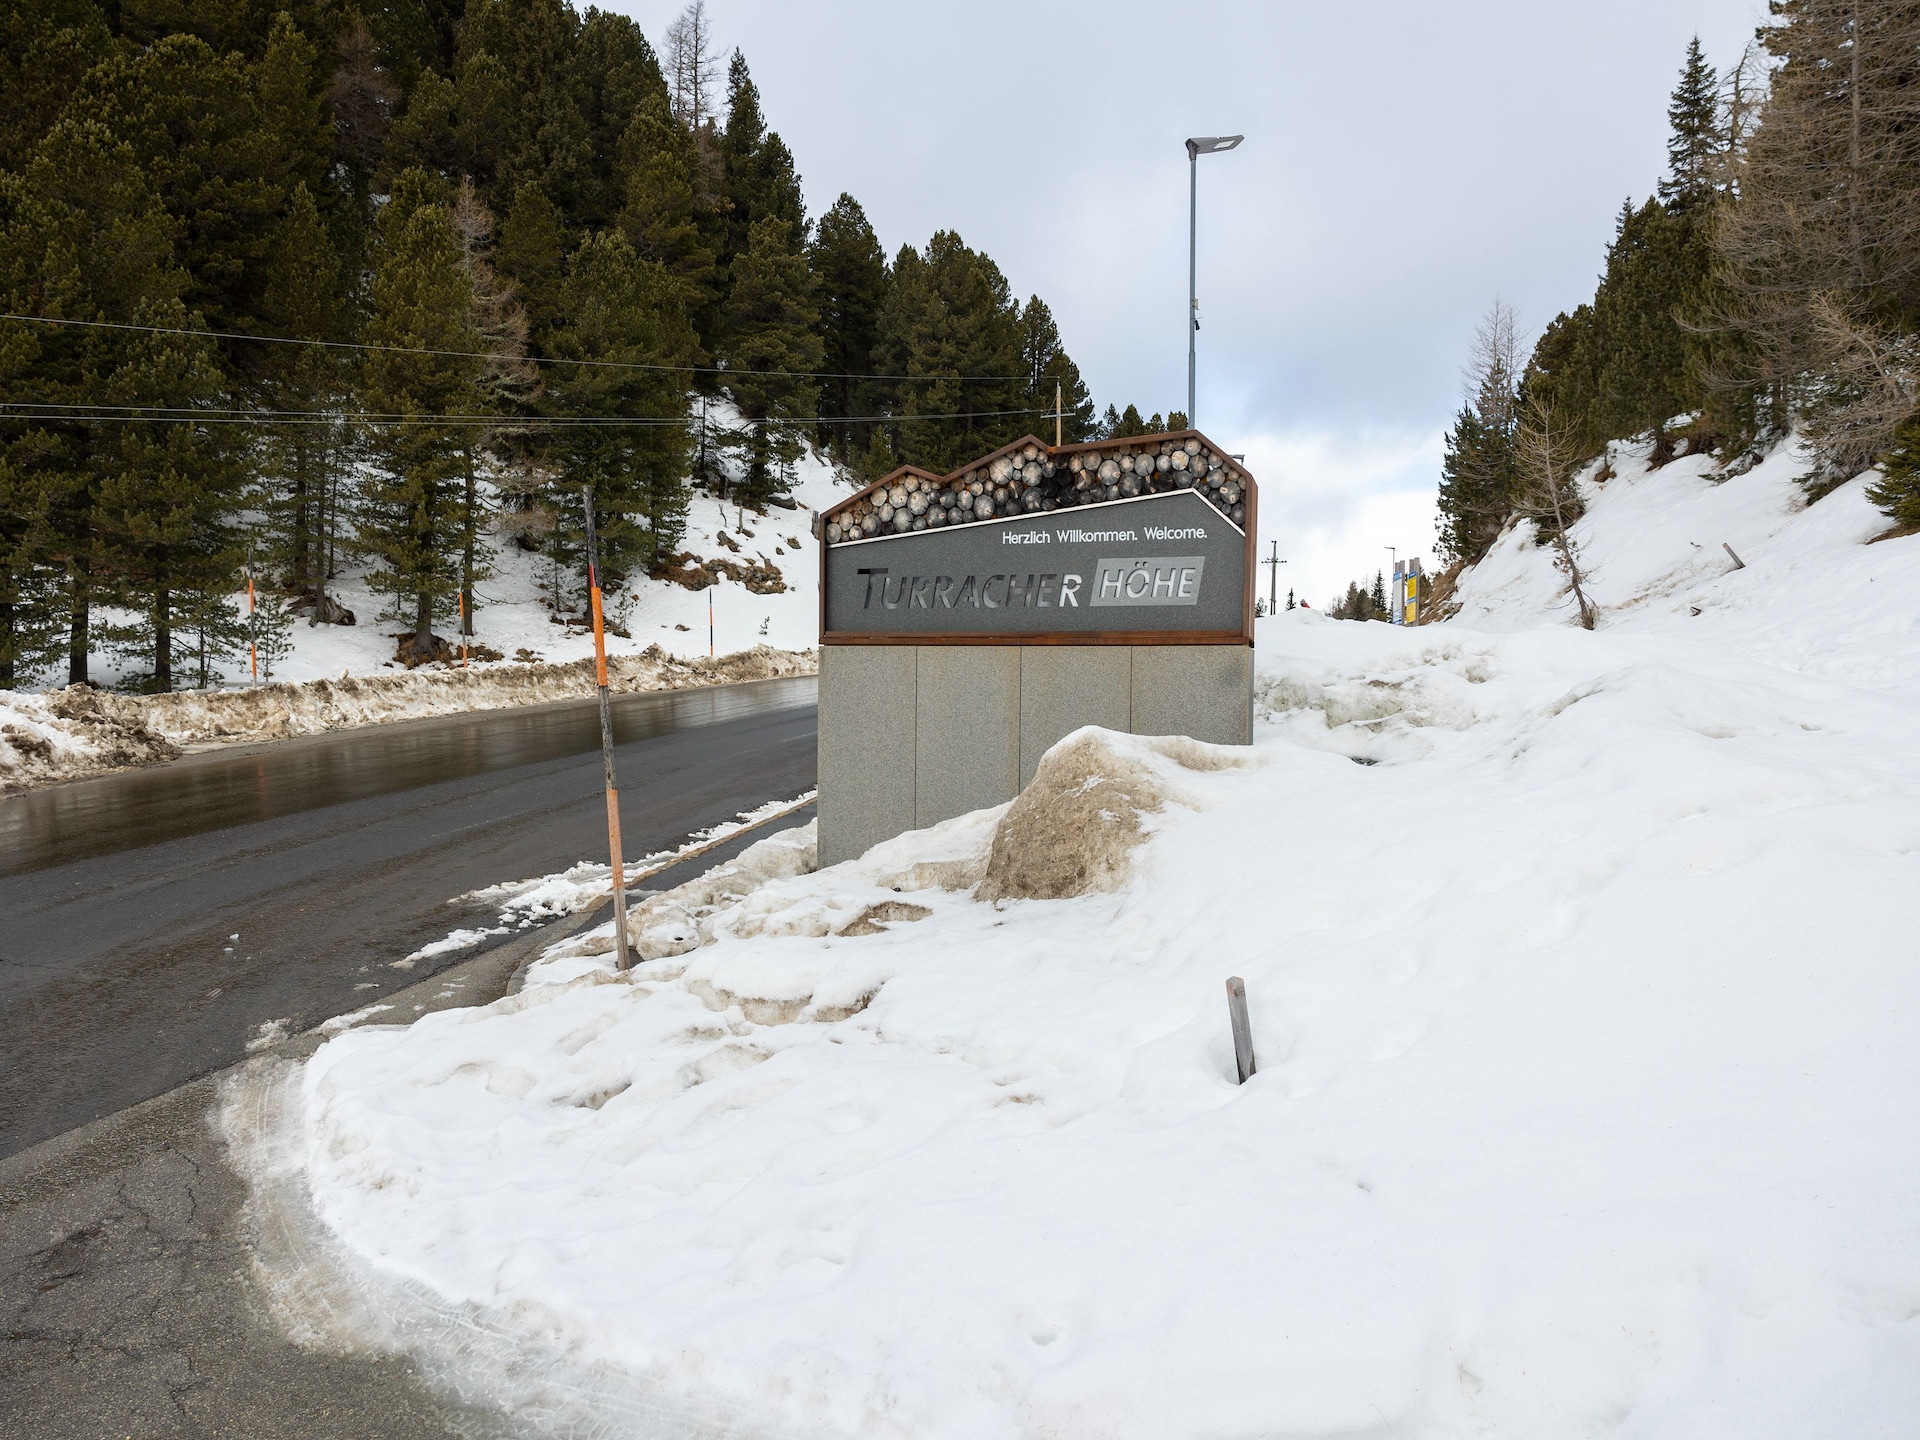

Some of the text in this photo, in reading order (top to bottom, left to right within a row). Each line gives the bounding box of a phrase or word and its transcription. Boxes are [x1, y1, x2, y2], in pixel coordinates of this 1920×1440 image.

[1002, 525, 1208, 546] Herzlich Willkommen. Welcome.
[857, 561, 1196, 609] TURRACHER HÖHE
